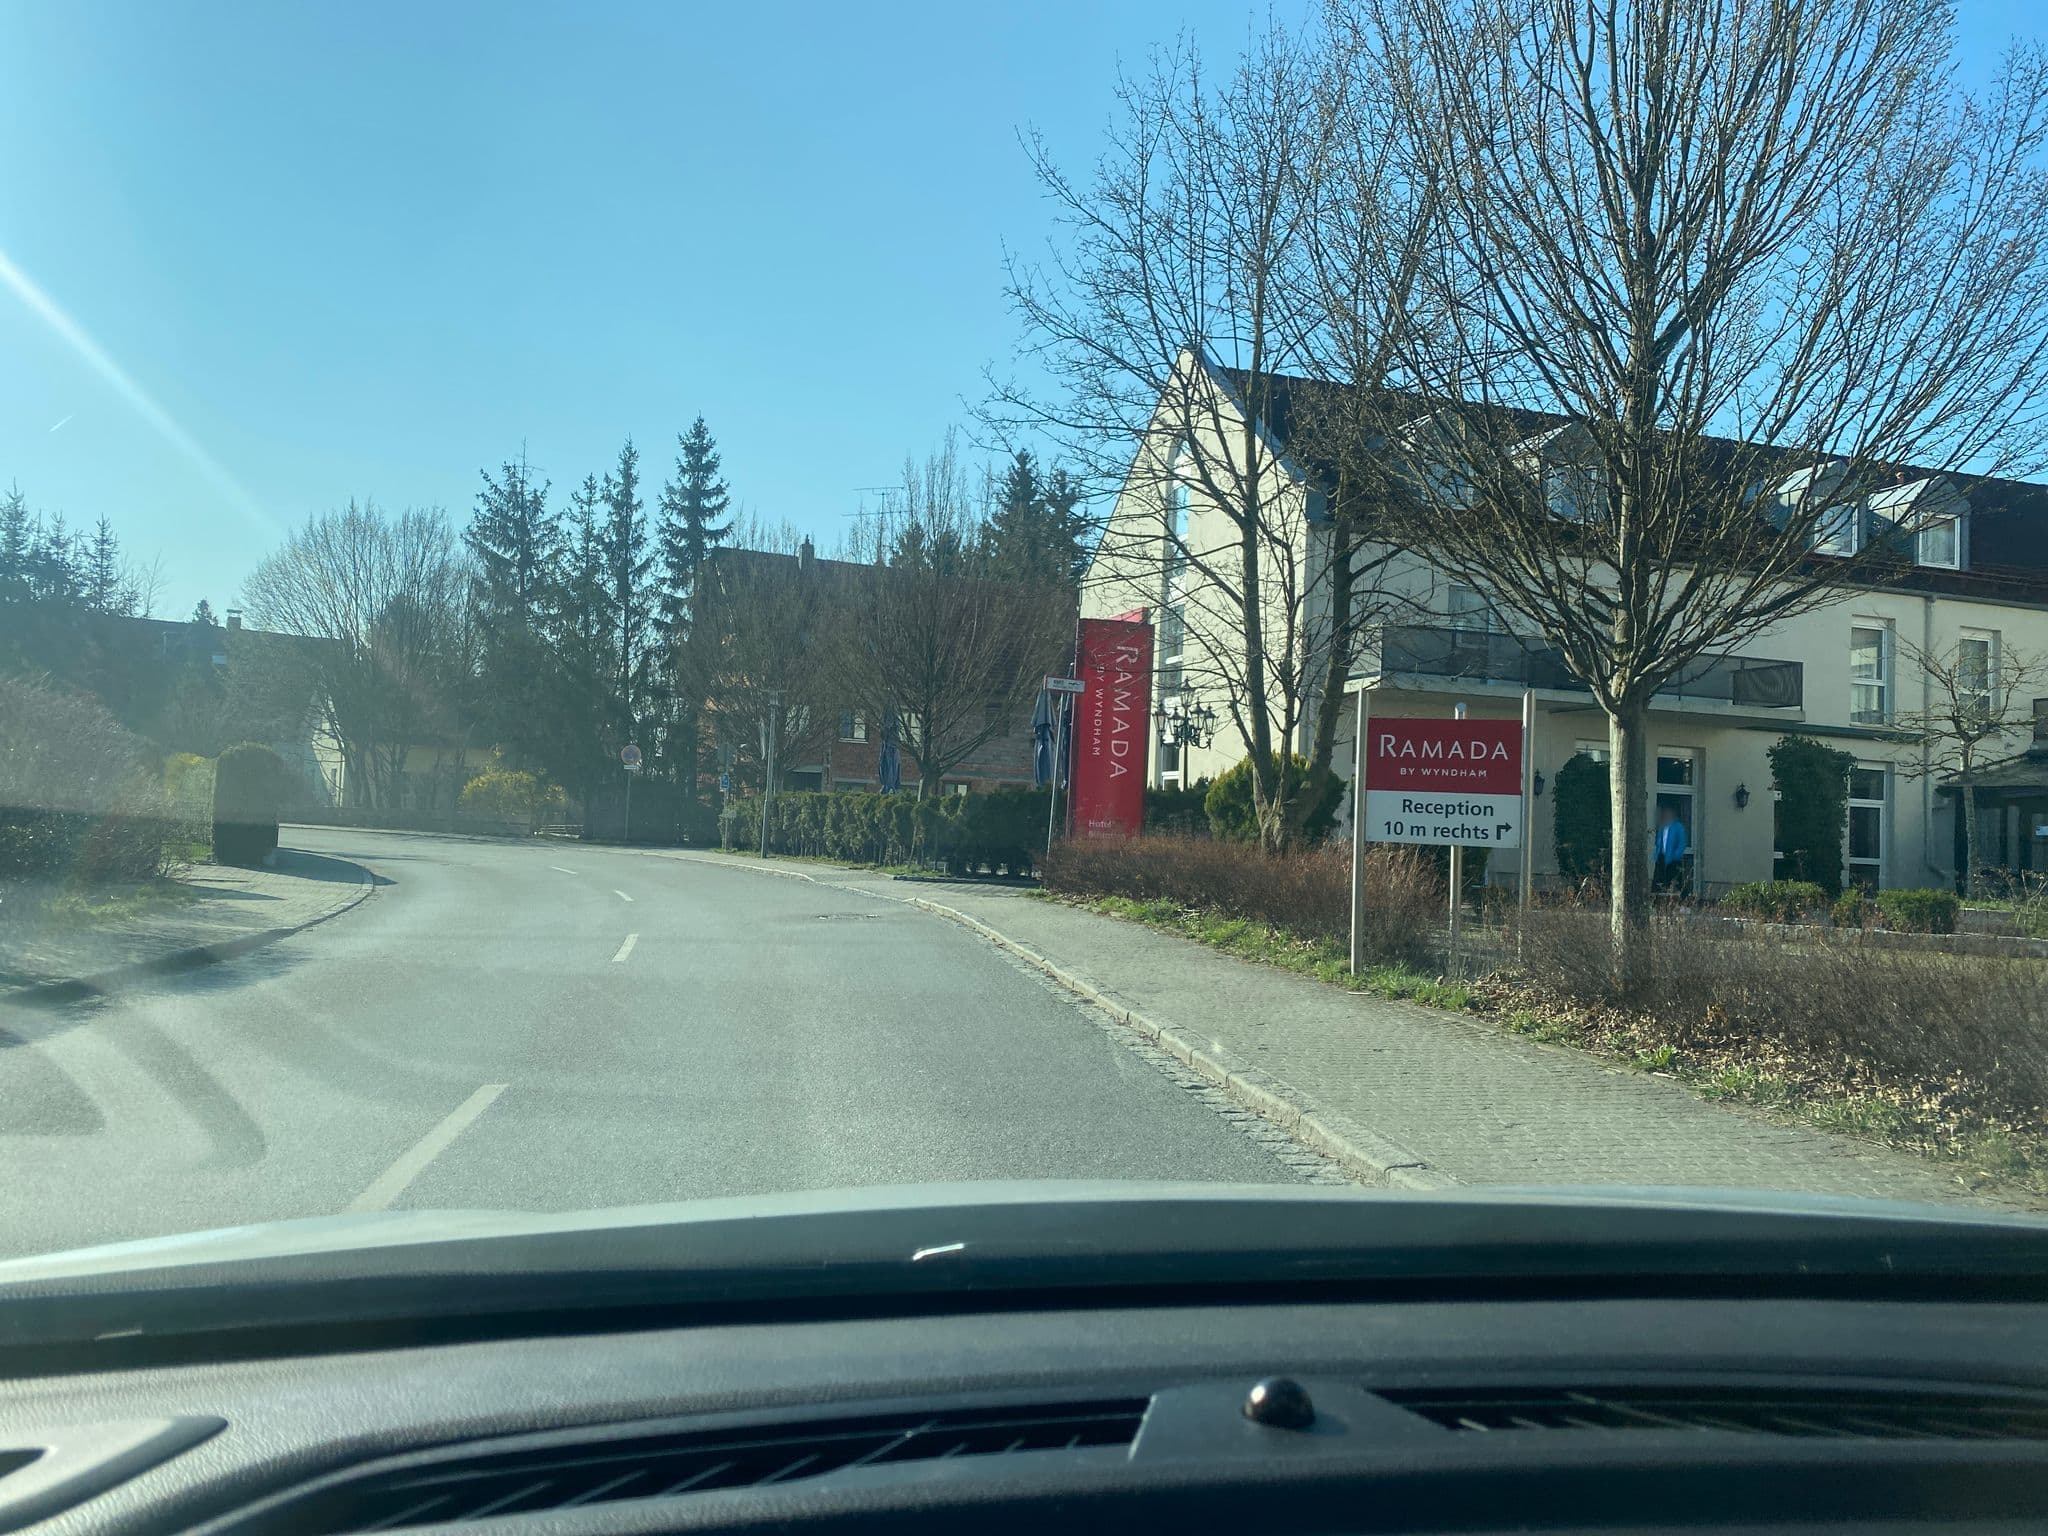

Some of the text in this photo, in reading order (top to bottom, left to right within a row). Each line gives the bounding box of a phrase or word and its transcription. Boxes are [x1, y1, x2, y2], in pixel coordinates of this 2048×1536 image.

[1092, 688, 1105, 756] WYNDHAM
[1109, 646, 1139, 778] RAMADA
[1379, 734, 1509, 760] RAMADA
[1400, 767, 1487, 777] BY WYNDHAM
[1402, 798, 1494, 818] Reception
[1384, 821, 1489, 840] 10 m rechts
